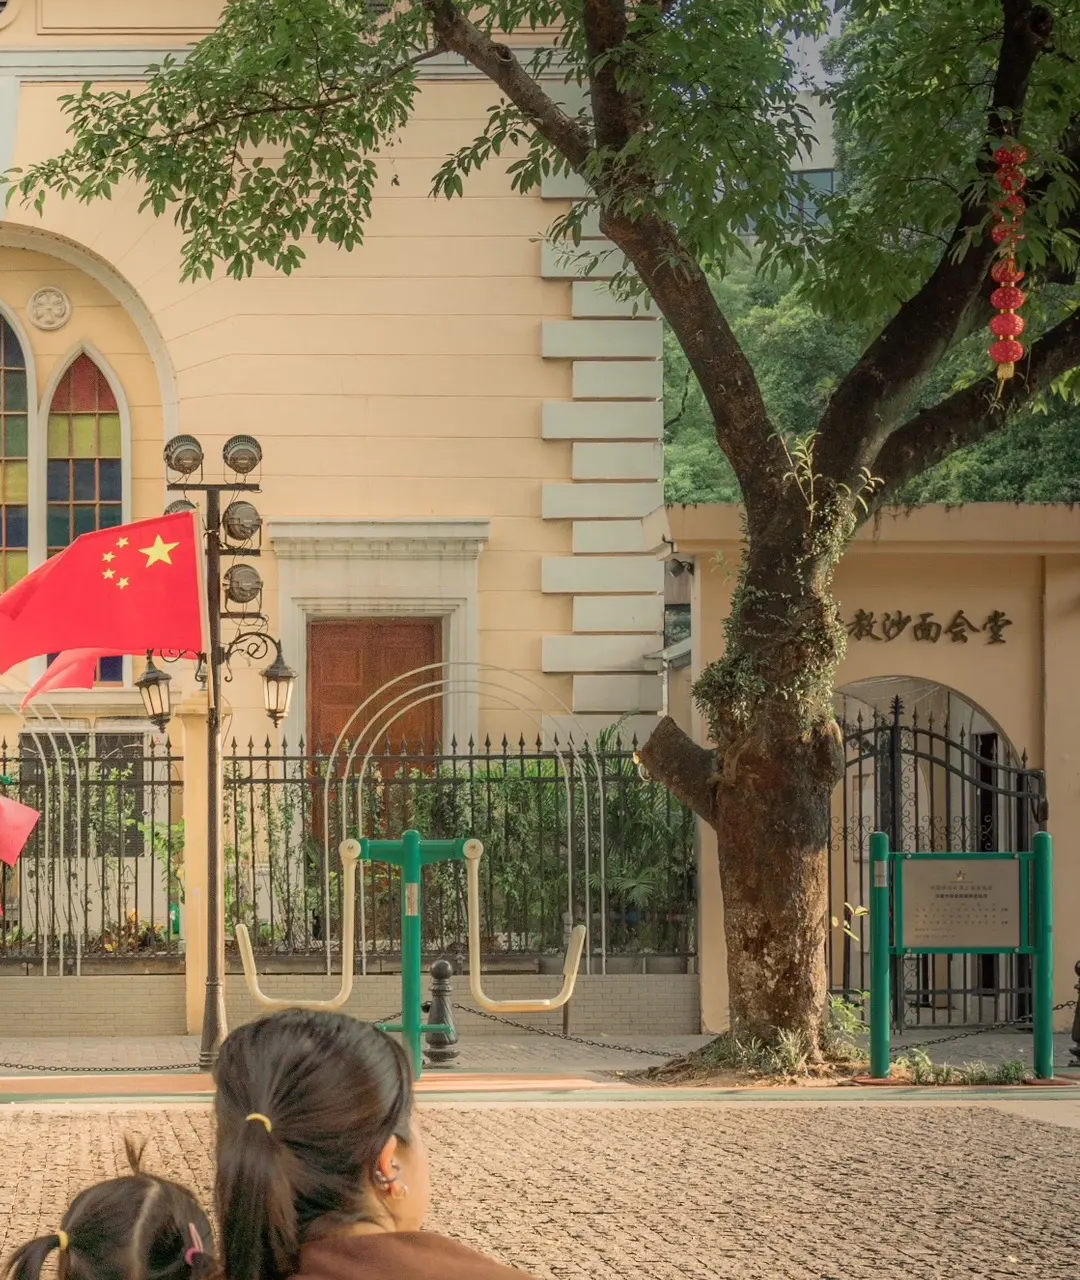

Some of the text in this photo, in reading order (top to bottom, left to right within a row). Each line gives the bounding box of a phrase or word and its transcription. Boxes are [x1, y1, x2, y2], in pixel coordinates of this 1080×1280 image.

[834, 608, 1013, 646] 教沙面会堂
